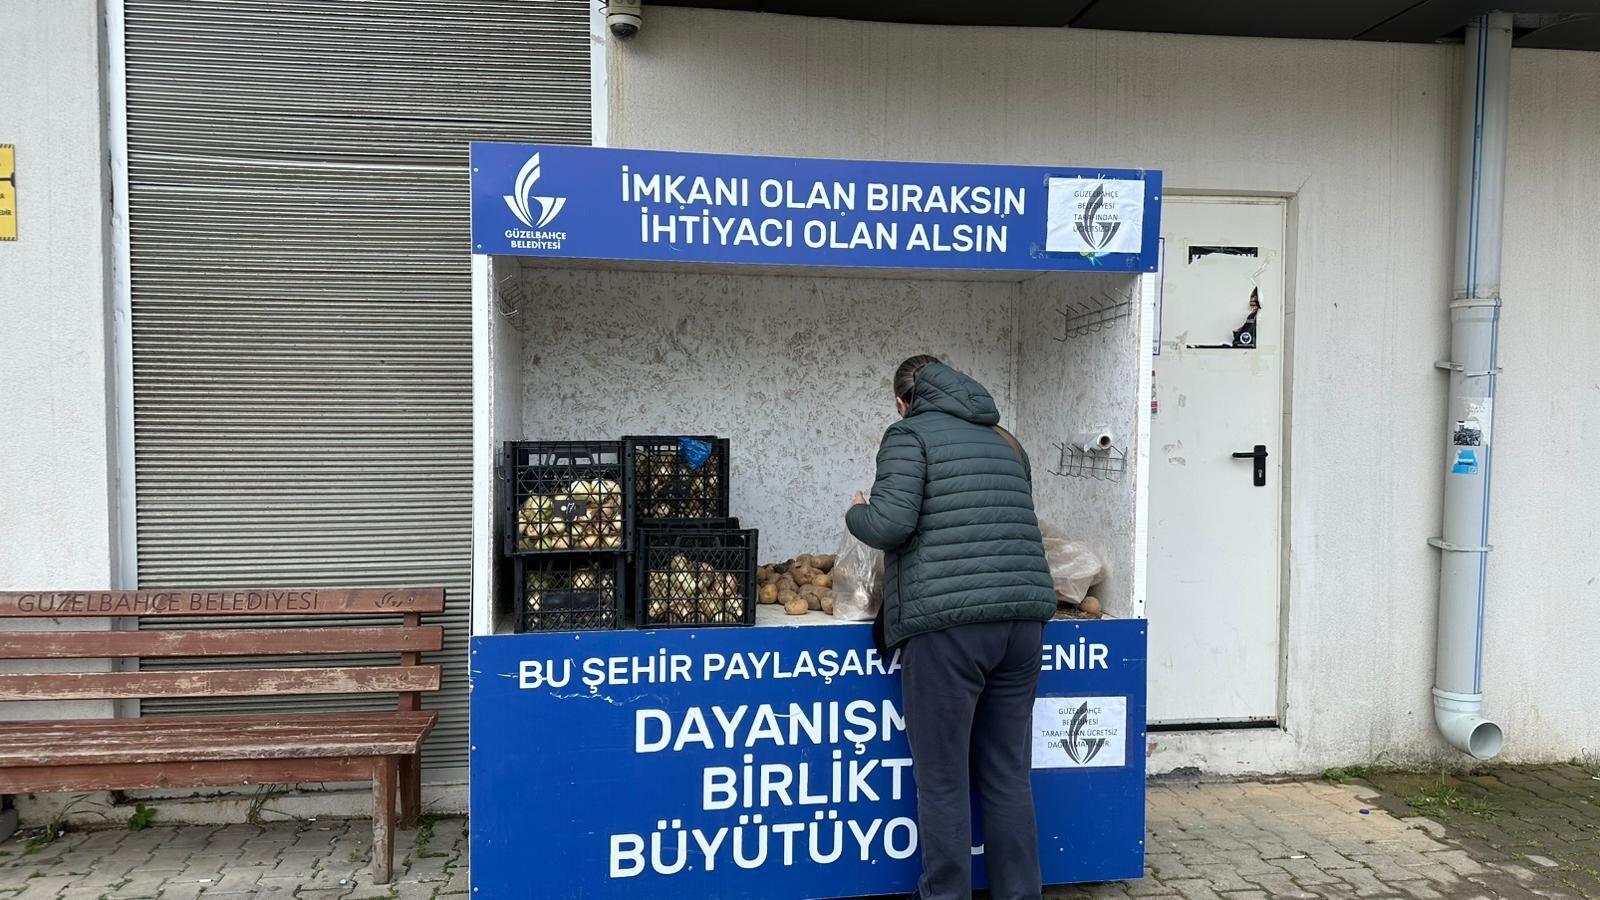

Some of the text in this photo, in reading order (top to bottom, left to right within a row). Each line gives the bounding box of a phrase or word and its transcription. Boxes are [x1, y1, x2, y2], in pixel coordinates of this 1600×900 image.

[622, 166, 1025, 215] İMKANI OLAN BIRAKSIN
[511, 239, 561, 249] BELEDİYESİ
[641, 207, 1007, 253] İHTİYACI OLAN ALSIN
[190, 591, 318, 611] BELEDİYESİ
[519, 637, 1109, 694] BU ŞEHİR PAYLAŞARA ENİR
[635, 699, 906, 755] DAYANIŞM
[703, 750, 918, 810] BİRLİKT
[609, 810, 984, 878] BÜYÜTÜYO
